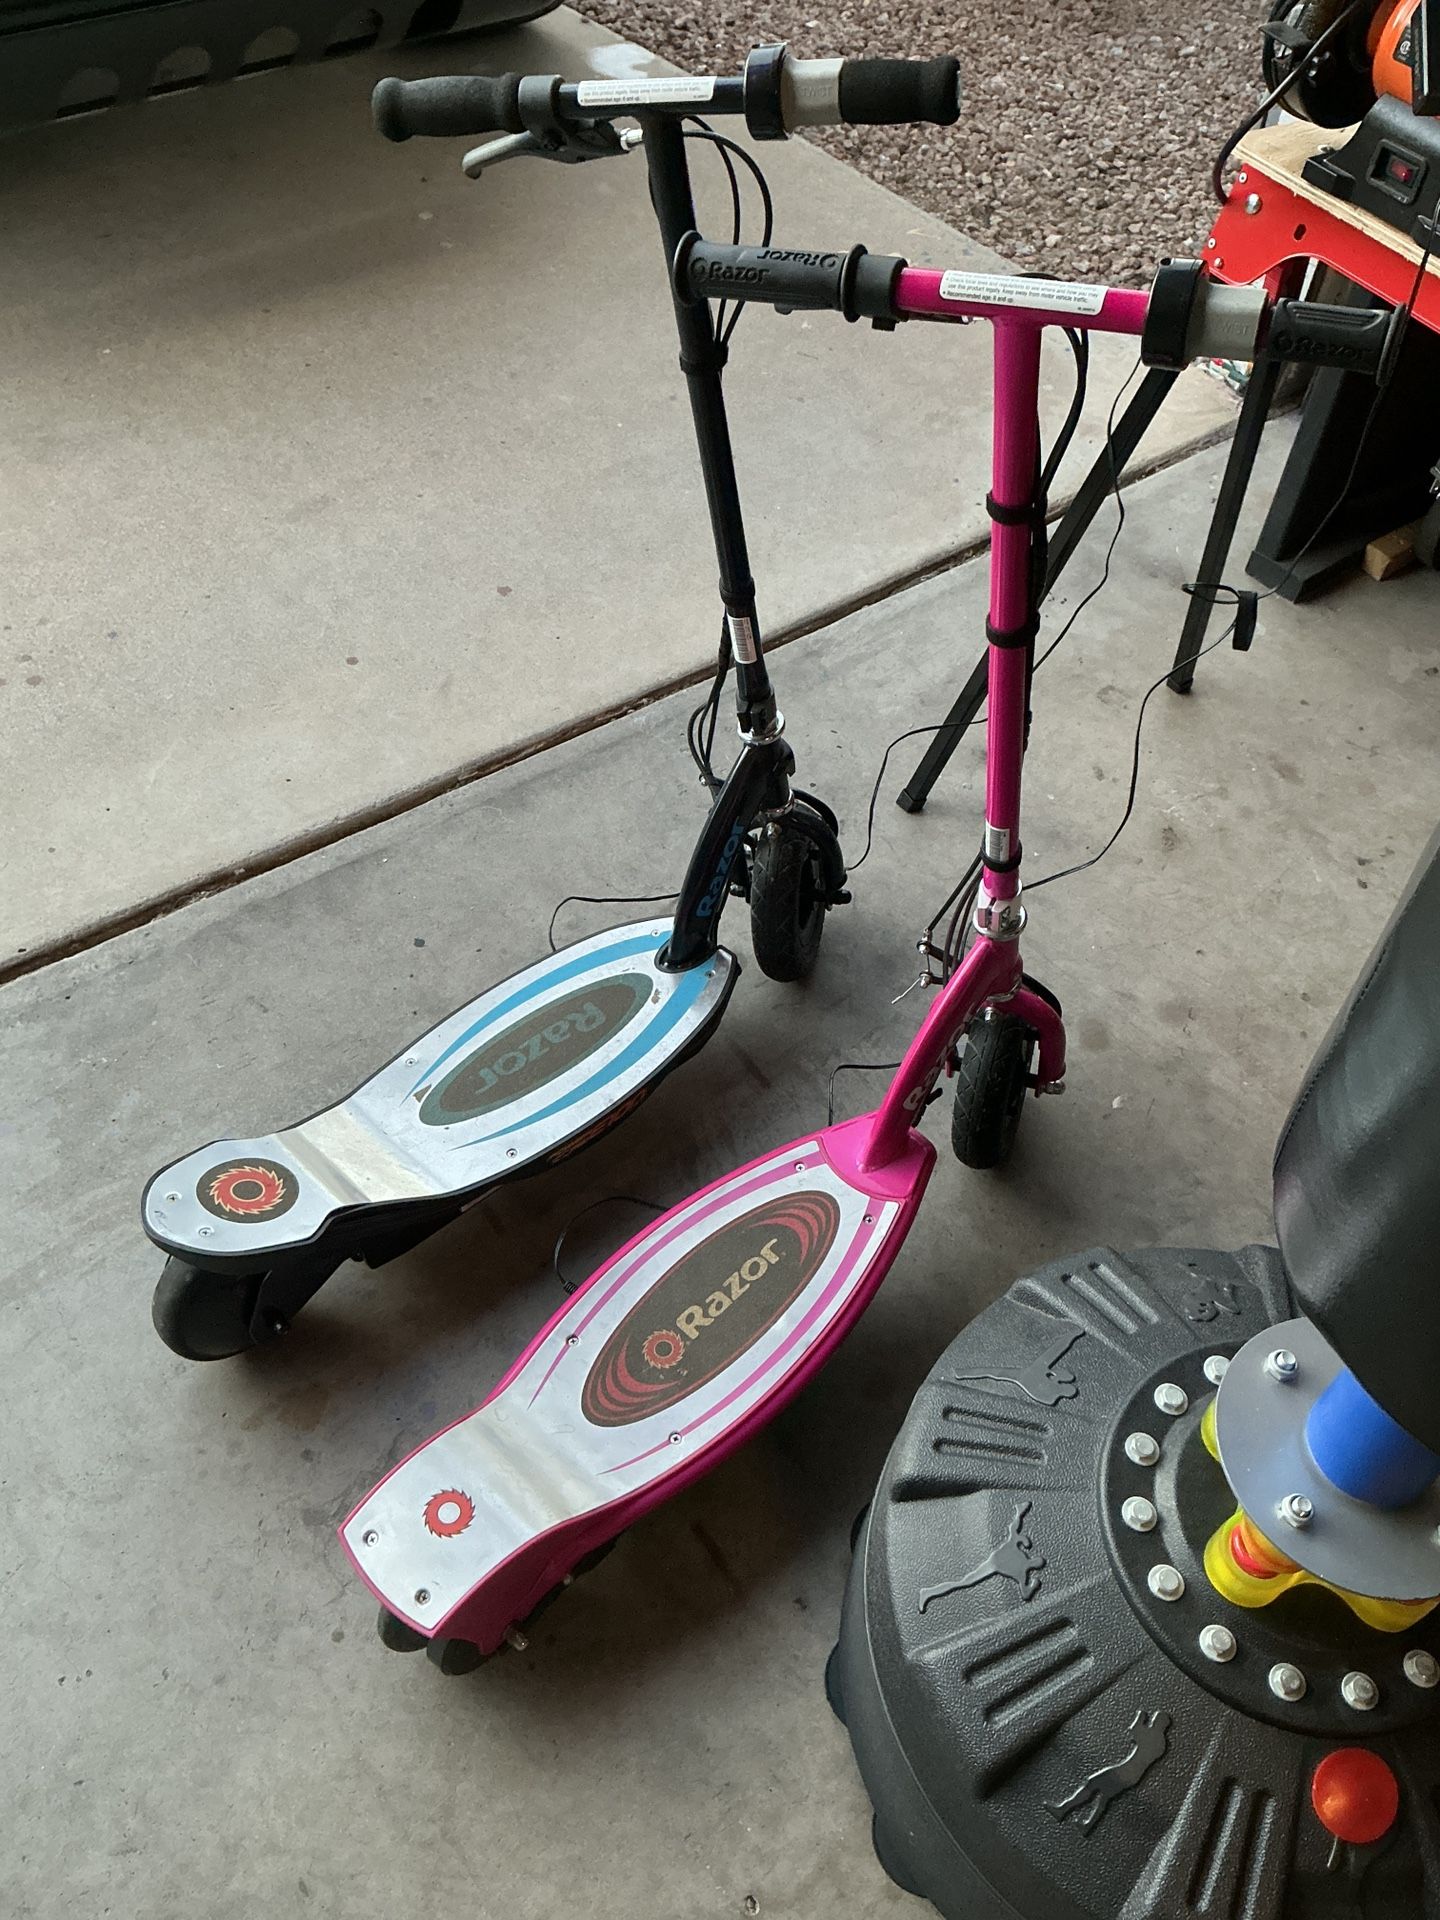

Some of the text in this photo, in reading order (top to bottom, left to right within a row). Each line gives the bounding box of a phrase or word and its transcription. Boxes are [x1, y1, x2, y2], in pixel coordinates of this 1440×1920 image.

[708, 260, 771, 285] Razor
[757, 250, 820, 267] Razor
[695, 815, 745, 918] Razor
[474, 1001, 606, 1096] Razor
[675, 1237, 780, 1340] Razor
